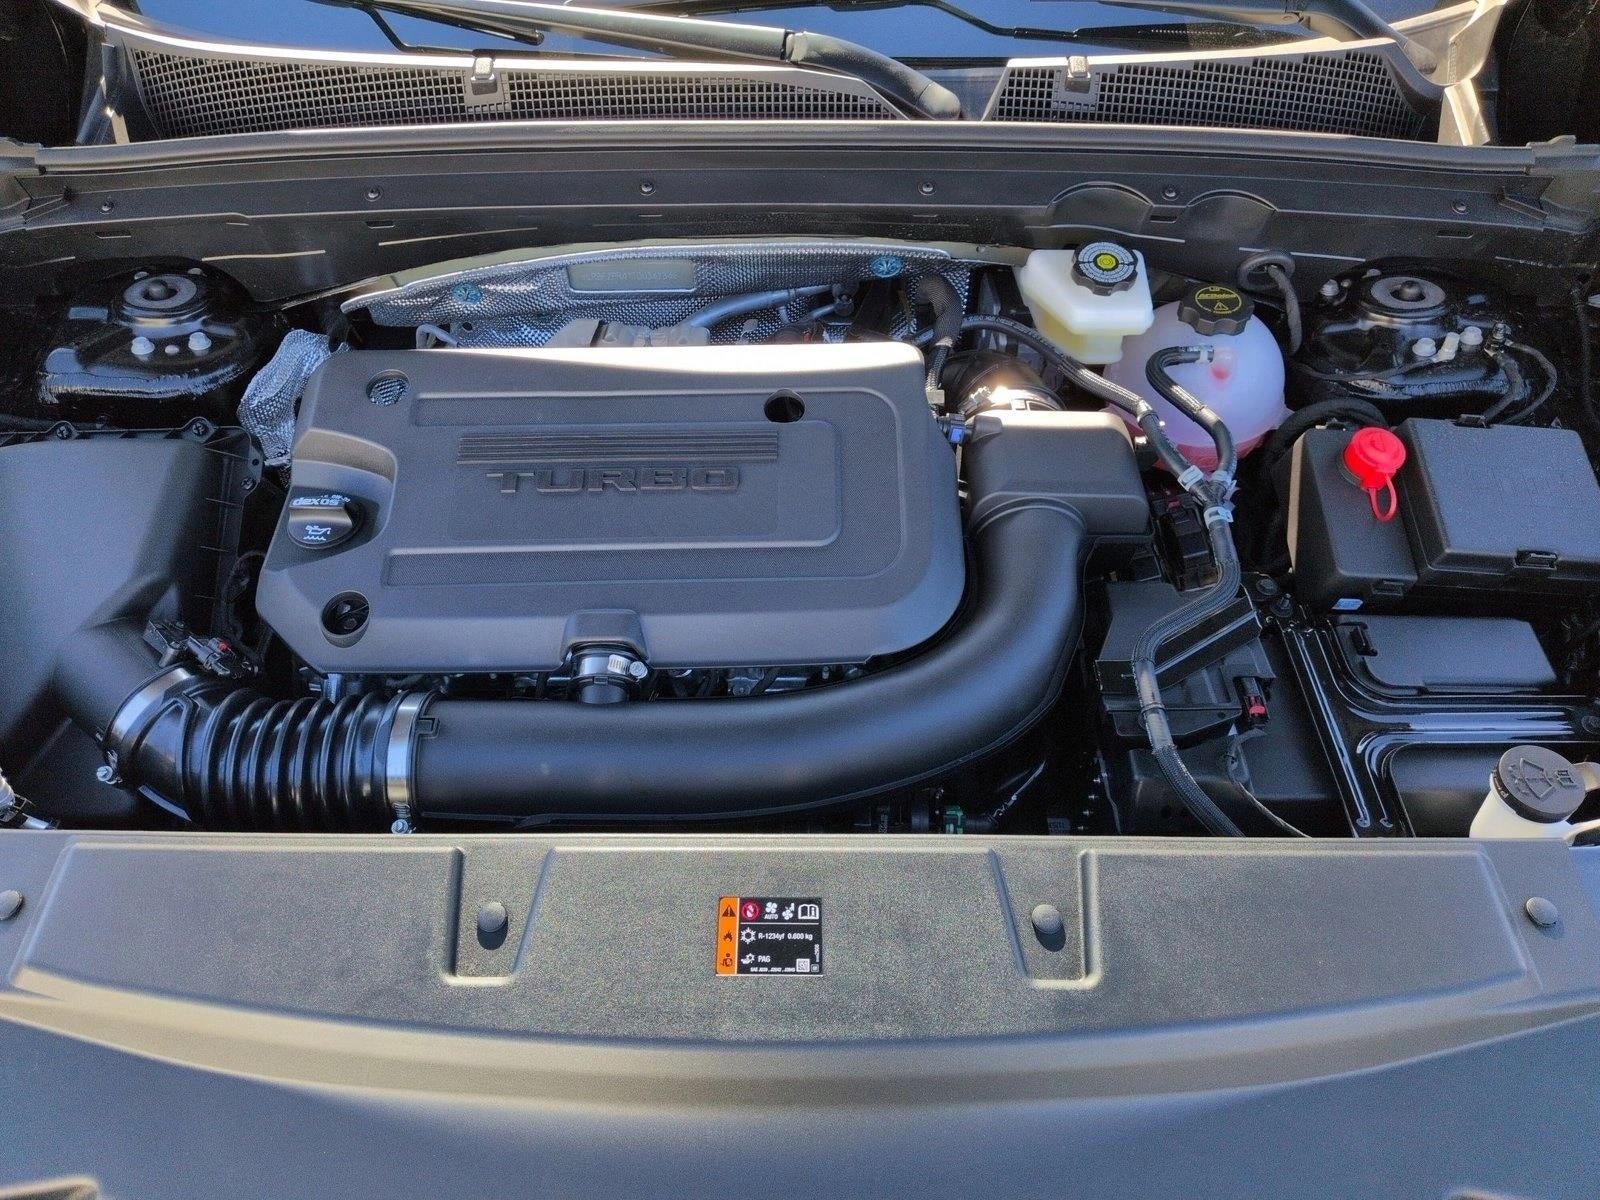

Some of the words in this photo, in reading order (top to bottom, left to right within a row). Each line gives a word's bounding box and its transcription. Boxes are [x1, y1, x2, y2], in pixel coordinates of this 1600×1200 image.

[485, 467, 739, 494] TURBO
[758, 932, 785, 941] R-1234yf
[805, 932, 813, 941] kg
[758, 955, 771, 963] PAG
